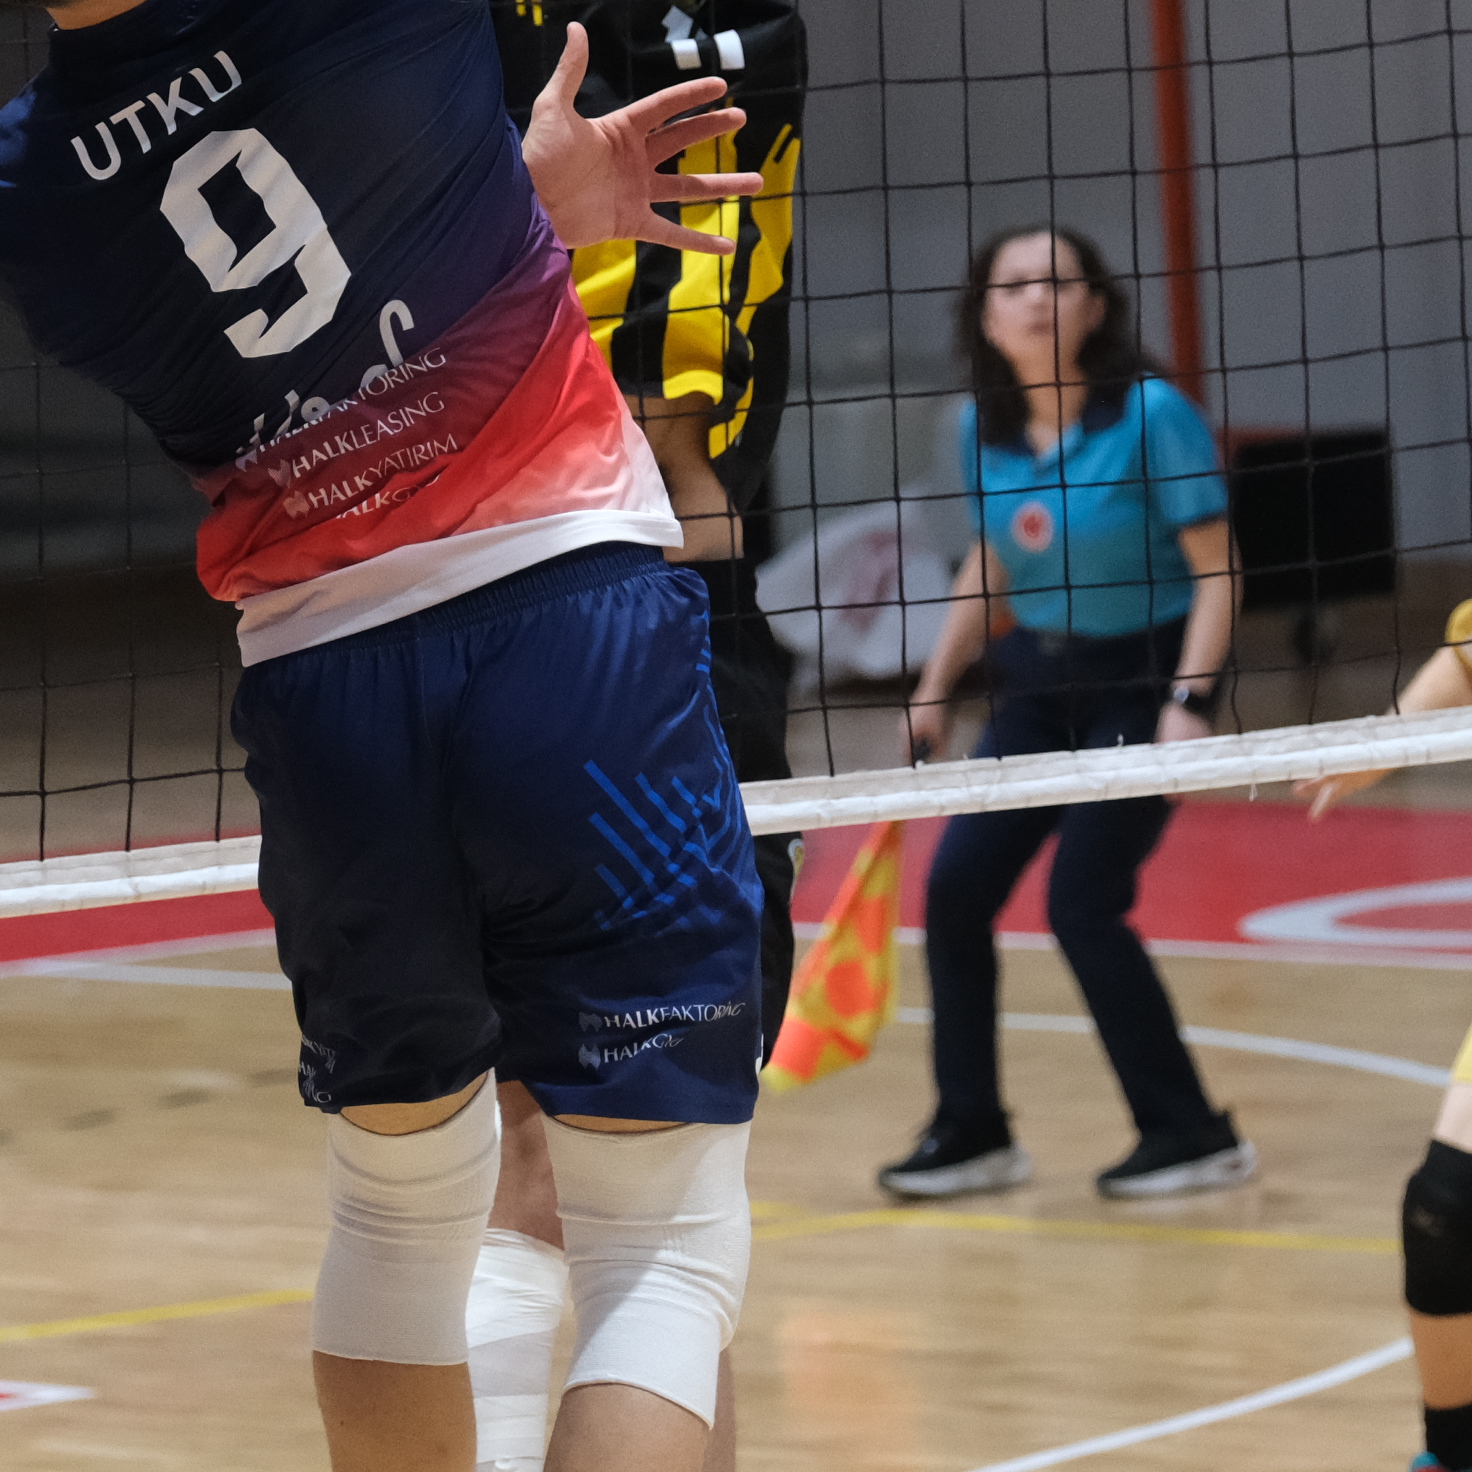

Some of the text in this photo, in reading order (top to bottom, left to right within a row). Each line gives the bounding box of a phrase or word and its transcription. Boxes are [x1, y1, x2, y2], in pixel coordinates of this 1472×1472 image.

[70, 50, 243, 181] UTKU
[160, 128, 353, 359] 9
[292, 391, 445, 478] HALKLEASING
[307, 433, 458, 509] HALKYATIRIM
